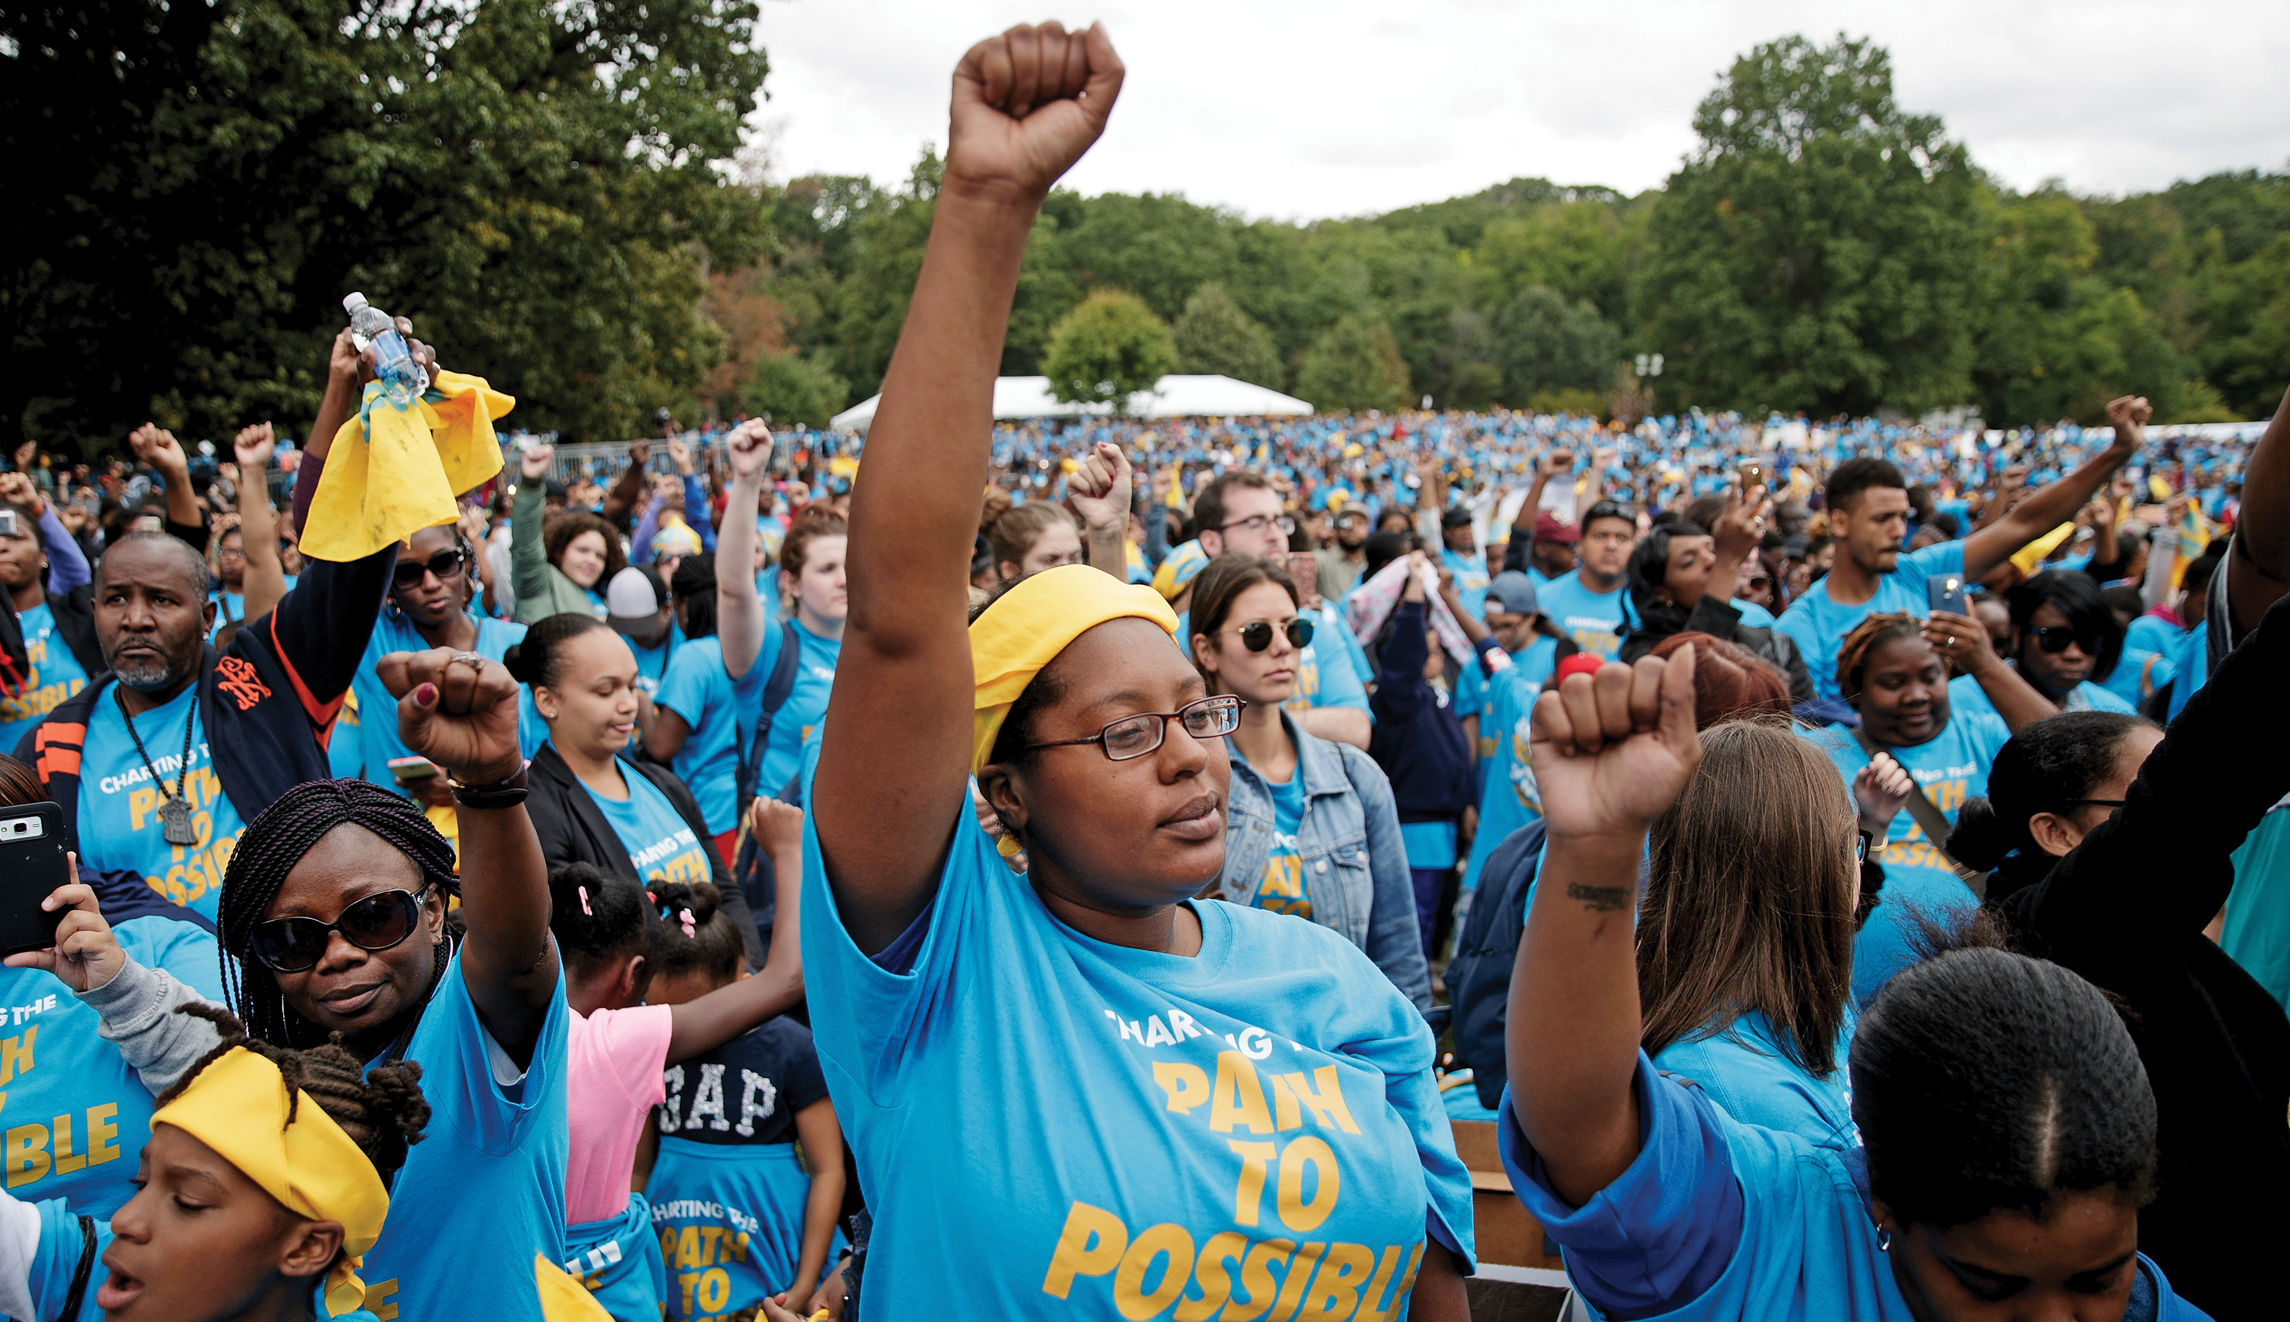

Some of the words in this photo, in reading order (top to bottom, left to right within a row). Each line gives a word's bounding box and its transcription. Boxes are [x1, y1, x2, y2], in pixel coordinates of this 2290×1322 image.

[1923, 779, 1967, 812] TH
[172, 811, 213, 863] O
[1258, 854, 1311, 898] AT
[11, 994, 57, 1026] THE
[659, 1063, 777, 1138] GAP
[0, 1101, 121, 1189] BLE
[1227, 1136, 1340, 1232] TO
[660, 1225, 750, 1271] PATH
[677, 1267, 731, 1315] TO
